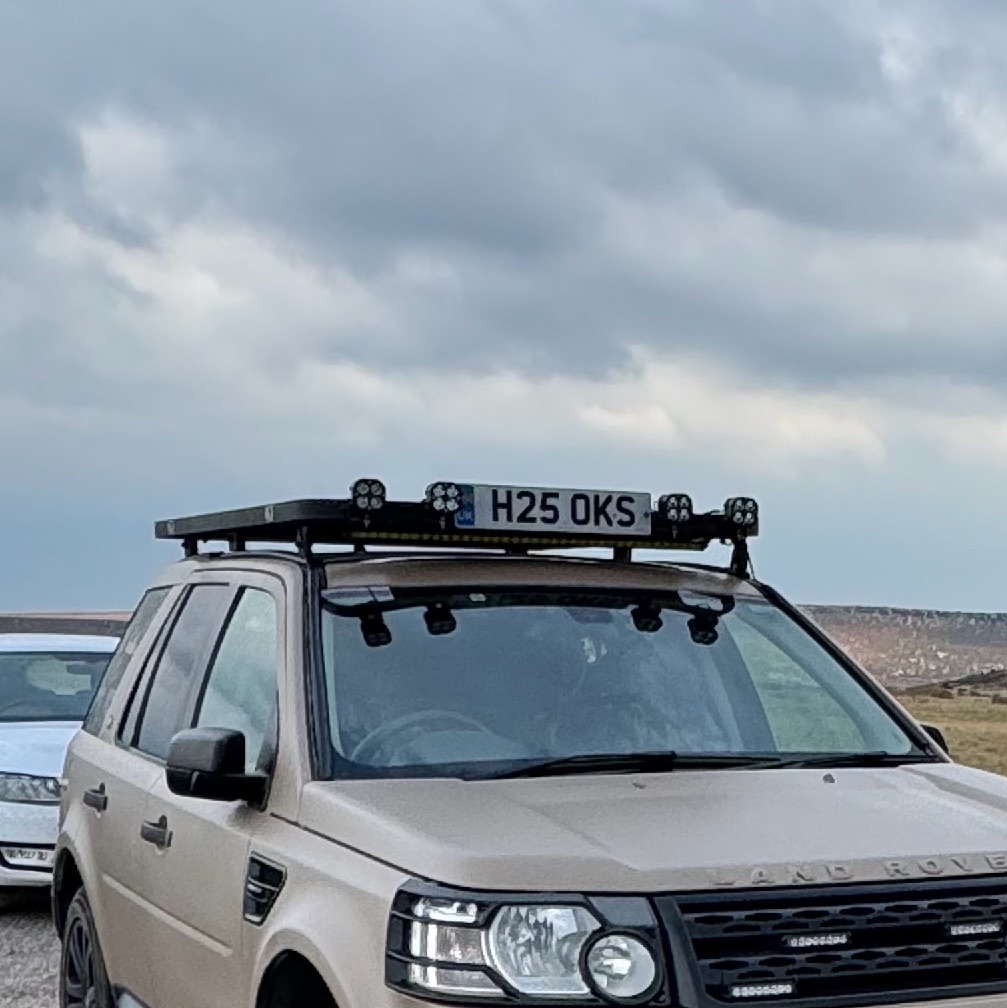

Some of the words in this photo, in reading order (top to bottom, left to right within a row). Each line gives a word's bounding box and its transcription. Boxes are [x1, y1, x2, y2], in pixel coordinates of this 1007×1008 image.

[492, 489, 560, 524] H25
[571, 493, 636, 527] OKS
[708, 863, 854, 886] LAND
